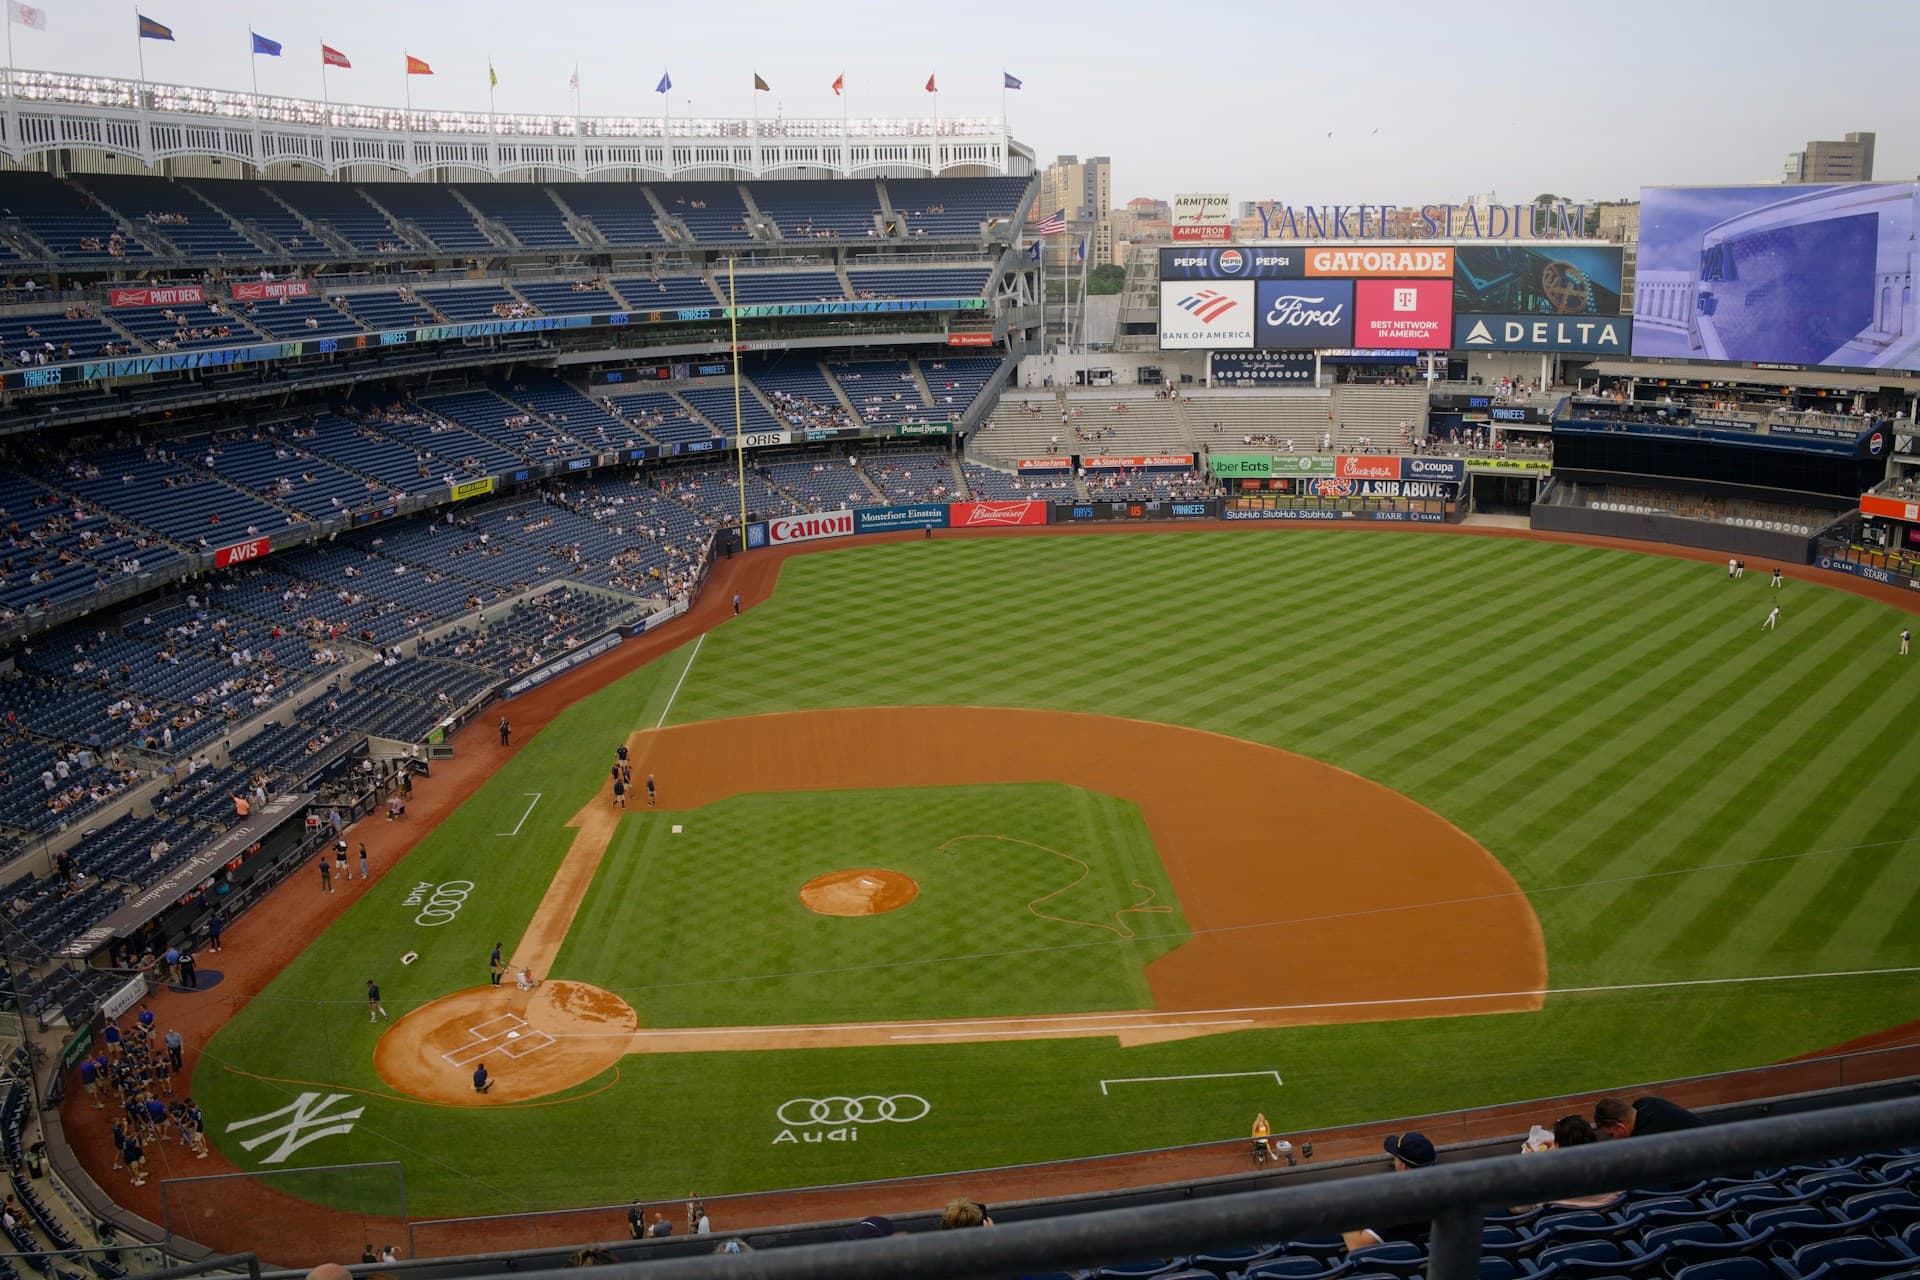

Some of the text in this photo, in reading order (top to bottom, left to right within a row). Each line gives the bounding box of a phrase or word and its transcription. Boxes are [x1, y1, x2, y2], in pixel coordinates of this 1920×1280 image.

[1176, 198, 1228, 206] ARMITRON
[1257, 204, 1586, 238] YANKEE STADIUM
[1178, 227, 1226, 235] ARMITRON
[1174, 257, 1207, 267] PEPSI
[1221, 257, 1242, 265] PEPSI
[1255, 257, 1289, 267] PEPSI
[1314, 252, 1446, 271] GATORADE
[265, 284, 288, 296] PARTY
[288, 283, 307, 295] DECK
[150, 290, 178, 303] PARTY
[178, 289, 201, 303] DECK
[677, 308, 710, 320] YANKEES
[1266, 295, 1344, 327] Ford
[1371, 321, 1439, 329] BEST NETWORK
[1163, 331, 1251, 340] BANK OF AMERICA
[1379, 330, 1430, 338] IN AMERICA
[1505, 321, 1619, 345] DELTA
[698, 365, 726, 375] YANKEES
[24, 368, 61, 387] YANKEES
[1492, 408, 1525, 419] YANKEES
[902, 424, 948, 435] Poland Spring
[746, 433, 781, 446] ORIS
[688, 442, 713, 452] YANKEES
[1241, 461, 1269, 472] Eats
[1424, 463, 1454, 473] coupa
[1361, 481, 1370, 496] A
[1375, 481, 1399, 496] SUB
[861, 508, 942, 522] Montefiore Einstein
[971, 508, 1025, 519] Budweiser
[1073, 506, 1093, 517] RAYS
[1172, 504, 1204, 515] YANKEES
[1227, 510, 1333, 519] StubHub StubHub StubHub
[1376, 512, 1402, 520] STARR
[771, 516, 852, 541] Canon
[228, 542, 258, 564] AVIS
[1863, 567, 1889, 582] STARR
[132, 878, 175, 910] Stadium
[402, 881, 434, 906] Audi
[772, 1127, 858, 1144] Audi
